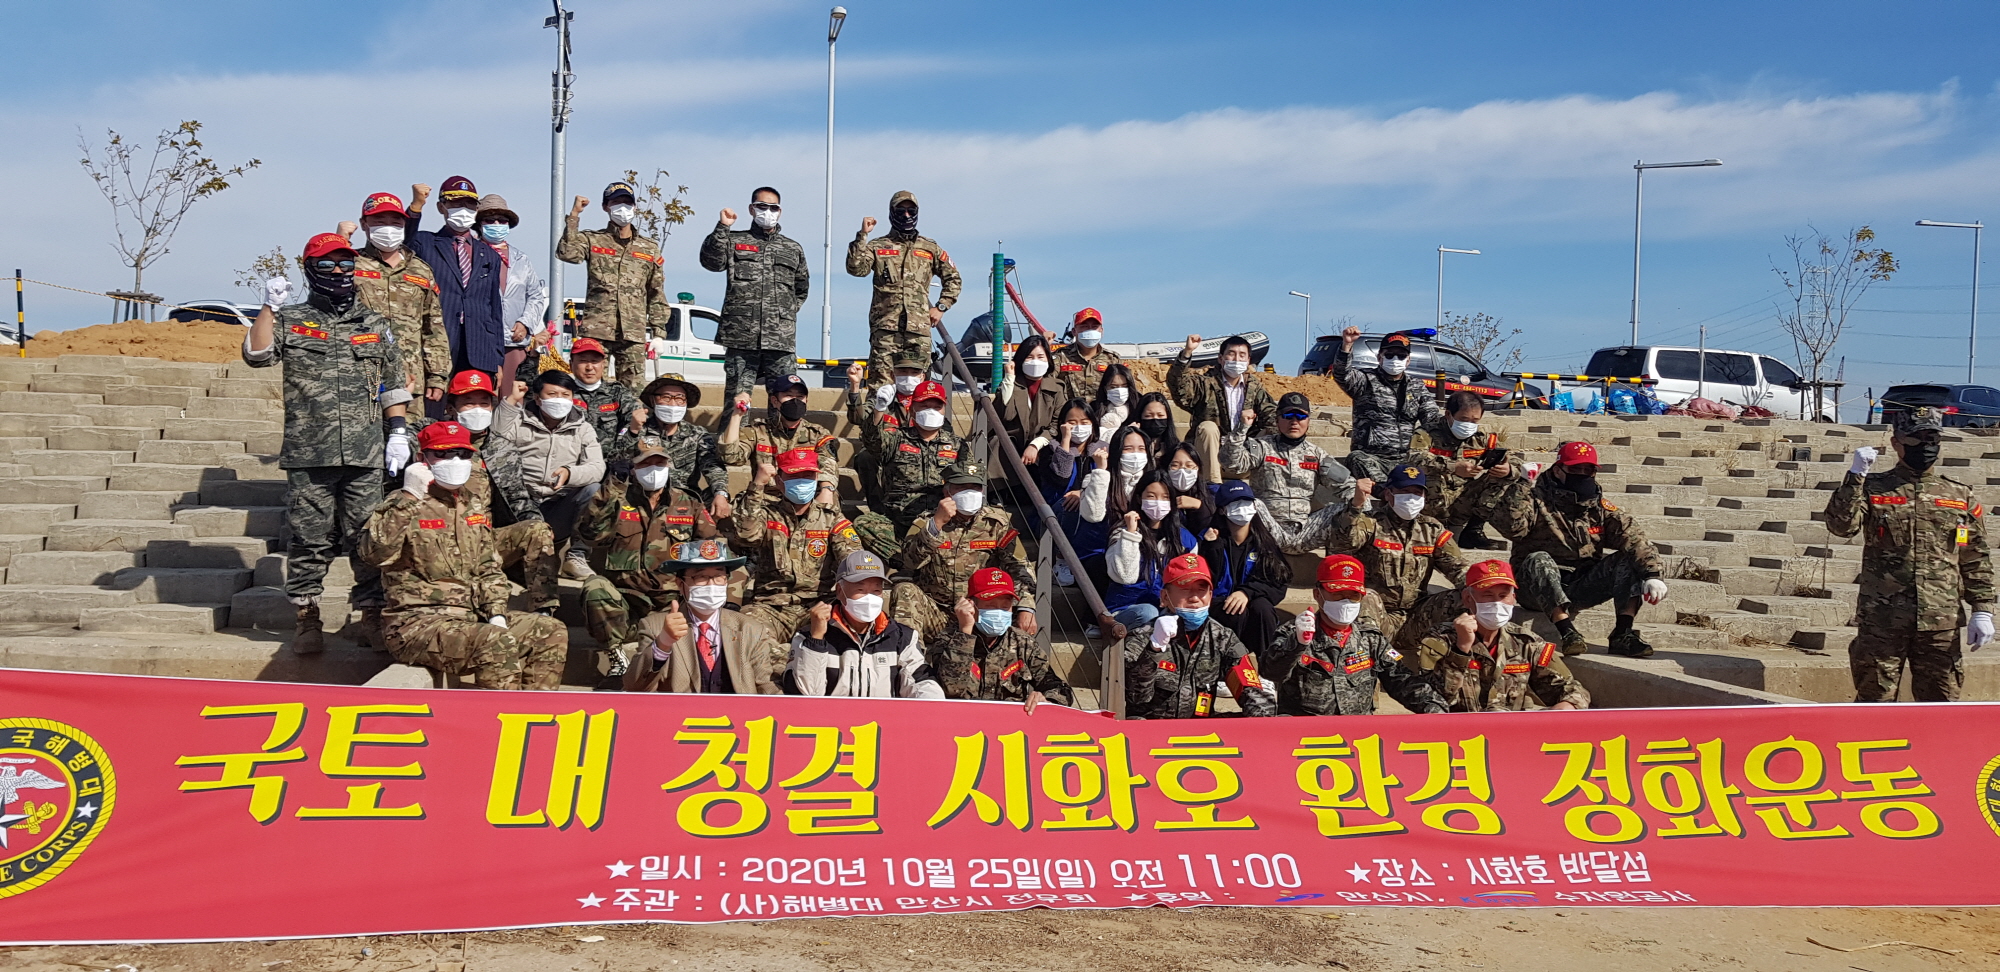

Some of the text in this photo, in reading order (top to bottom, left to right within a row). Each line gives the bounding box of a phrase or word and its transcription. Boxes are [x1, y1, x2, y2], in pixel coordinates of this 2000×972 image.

[175, 702, 1941, 844] 국토 대 청결 시화호 환경 정화운동
[20, 820, 88, 873] CORPS
[640, 855, 702, 881] 일시
[742, 857, 867, 887] 2020년
[882, 857, 956, 889] 10월
[967, 857, 1096, 890] 25일(일)
[1110, 859, 1167, 889] 오전
[1177, 853, 1302, 888] 11:00
[1372, 858, 1436, 887] 장소
[1465, 854, 1556, 885] 시화호
[1558, 850, 1652, 884] 반달섬
[612, 888, 680, 912] 주관
[720, 892, 884, 915] (사)해병대
[896, 895, 993, 912] 안산시
[1554, 890, 1698, 902] 수자원공사
